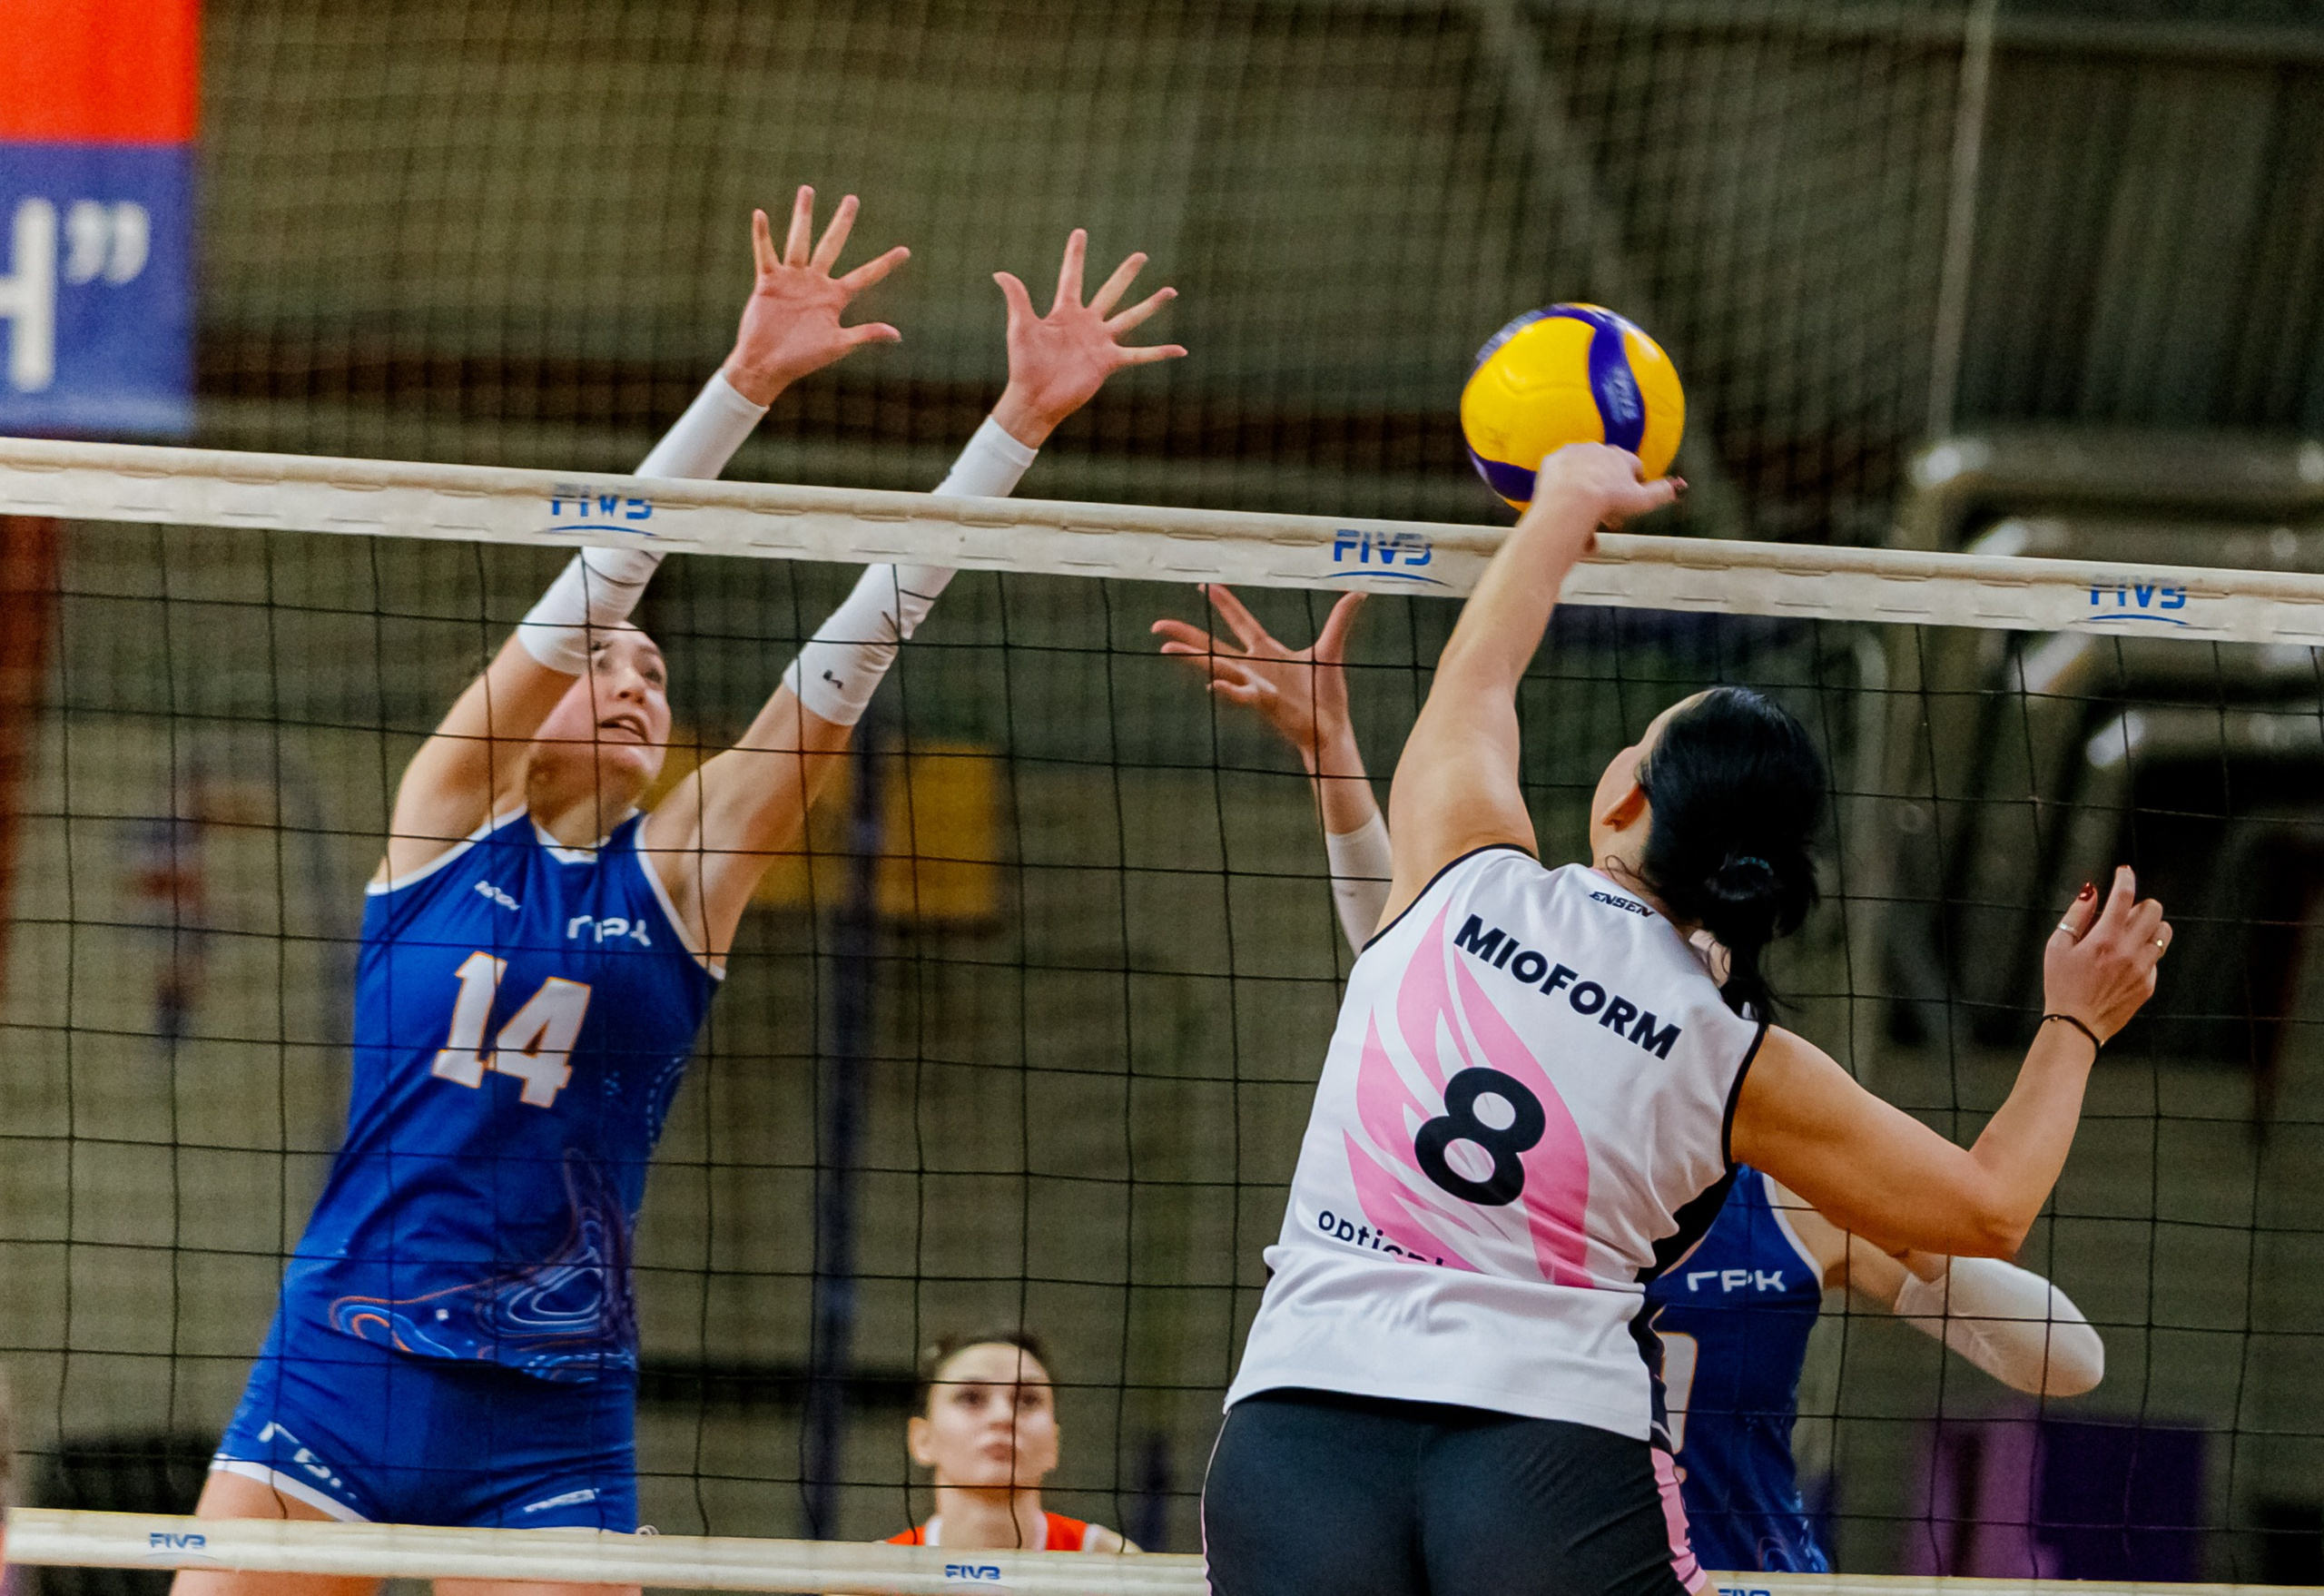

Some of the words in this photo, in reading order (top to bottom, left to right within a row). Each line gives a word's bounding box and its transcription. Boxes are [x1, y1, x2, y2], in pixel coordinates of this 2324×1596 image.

[1334, 528, 1434, 566] FIVB
[431, 951, 591, 1108] 14
[1453, 913, 1682, 1060] MIOFORM
[1414, 1067, 1546, 1207] 8
[150, 1532, 207, 1549] FIVB
[945, 1564, 1000, 1580] FIVB
